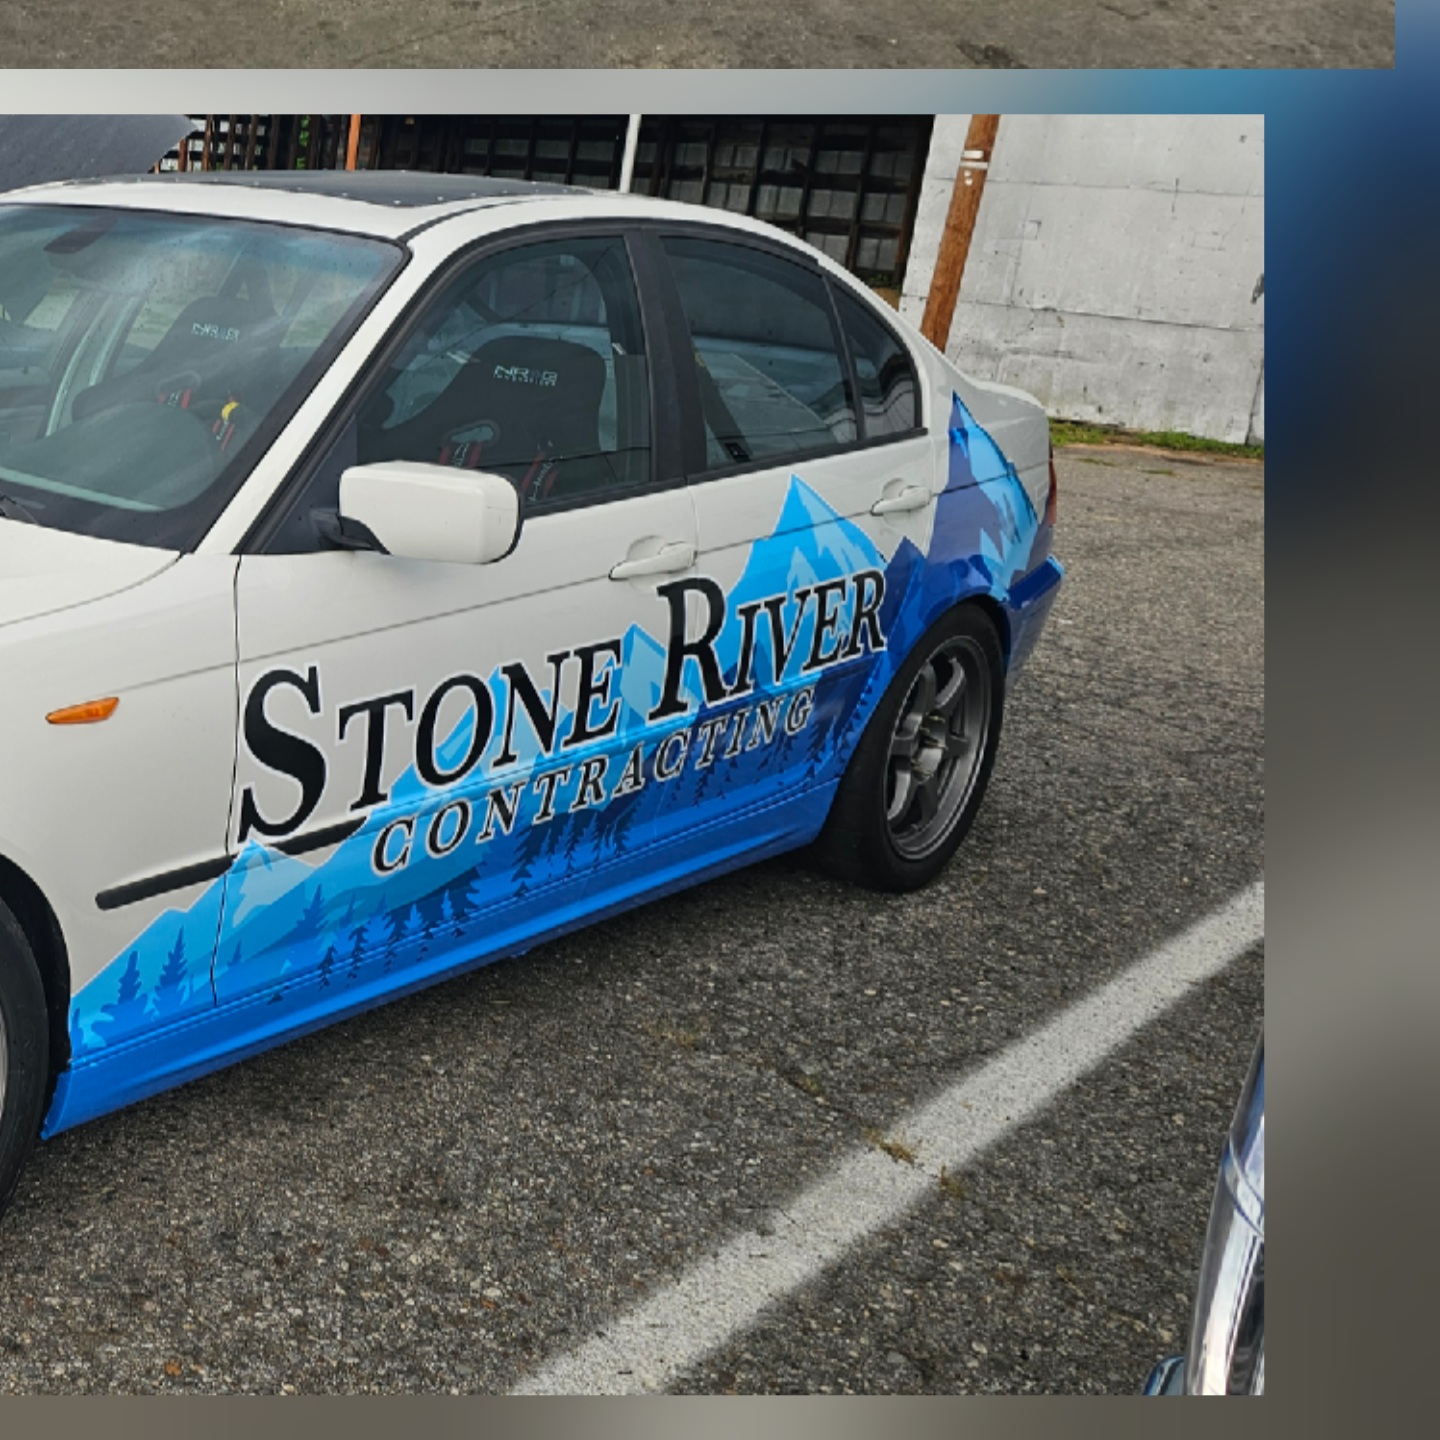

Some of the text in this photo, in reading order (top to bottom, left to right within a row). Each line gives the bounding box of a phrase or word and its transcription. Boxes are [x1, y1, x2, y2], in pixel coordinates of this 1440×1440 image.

[237, 569, 887, 844] STONE RIVER
[374, 687, 816, 873] CONTRACTING
